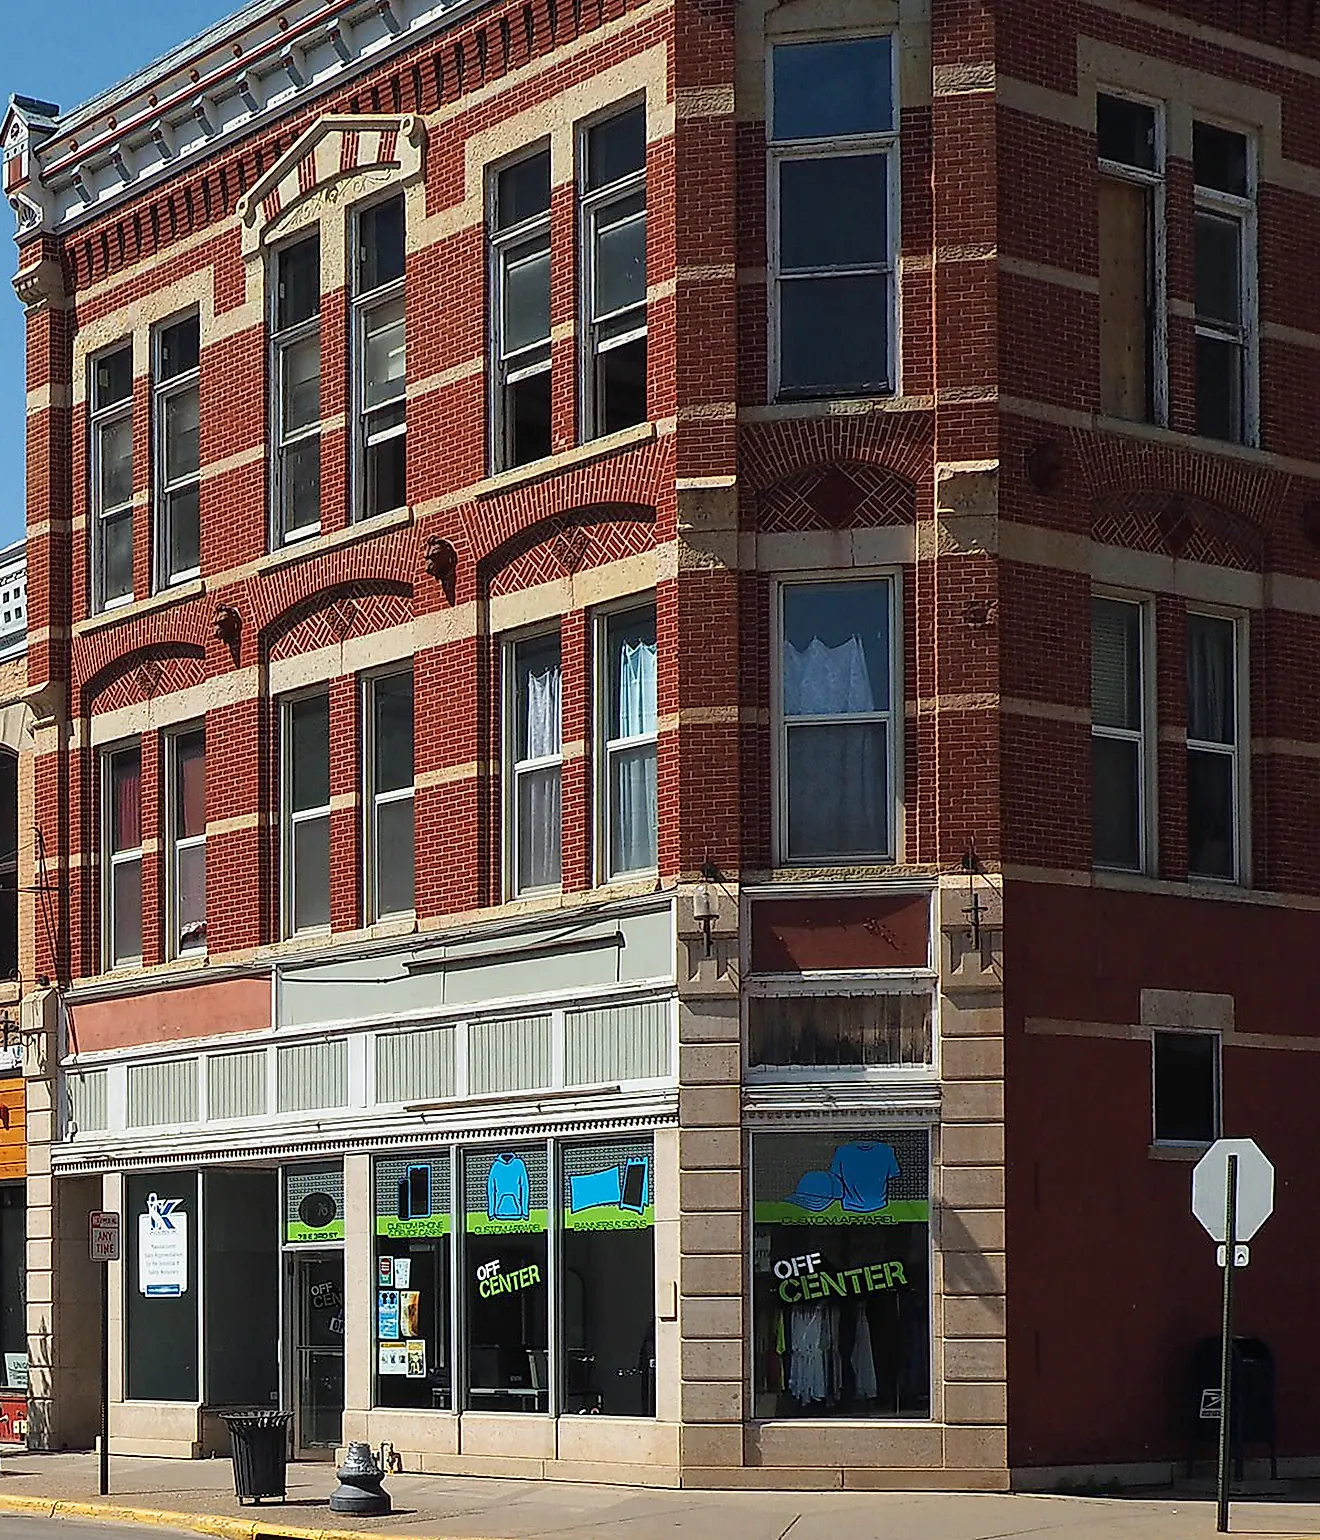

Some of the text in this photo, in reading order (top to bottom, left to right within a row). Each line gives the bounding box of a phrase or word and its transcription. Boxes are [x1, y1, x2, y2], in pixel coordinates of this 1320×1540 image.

[387, 1220, 443, 1230] CUSTOM PHONE
[574, 1220, 613, 1230] BANNERS
[622, 1219, 647, 1228] SIGNS
[781, 1214, 896, 1225] CUSTOM APPAREL
[329, 1230, 339, 1239] ST
[474, 1223, 541, 1235] CUSTOM APPAREL
[97, 1231, 112, 1241] ANY
[96, 1243, 114, 1254] TIME
[476, 1259, 501, 1280] OFF
[773, 1252, 822, 1279] OFF
[479, 1264, 541, 1299] CENTER
[778, 1260, 908, 1303] CENTER
[311, 1282, 333, 1295] OFF
[313, 1292, 342, 1308] CEN
